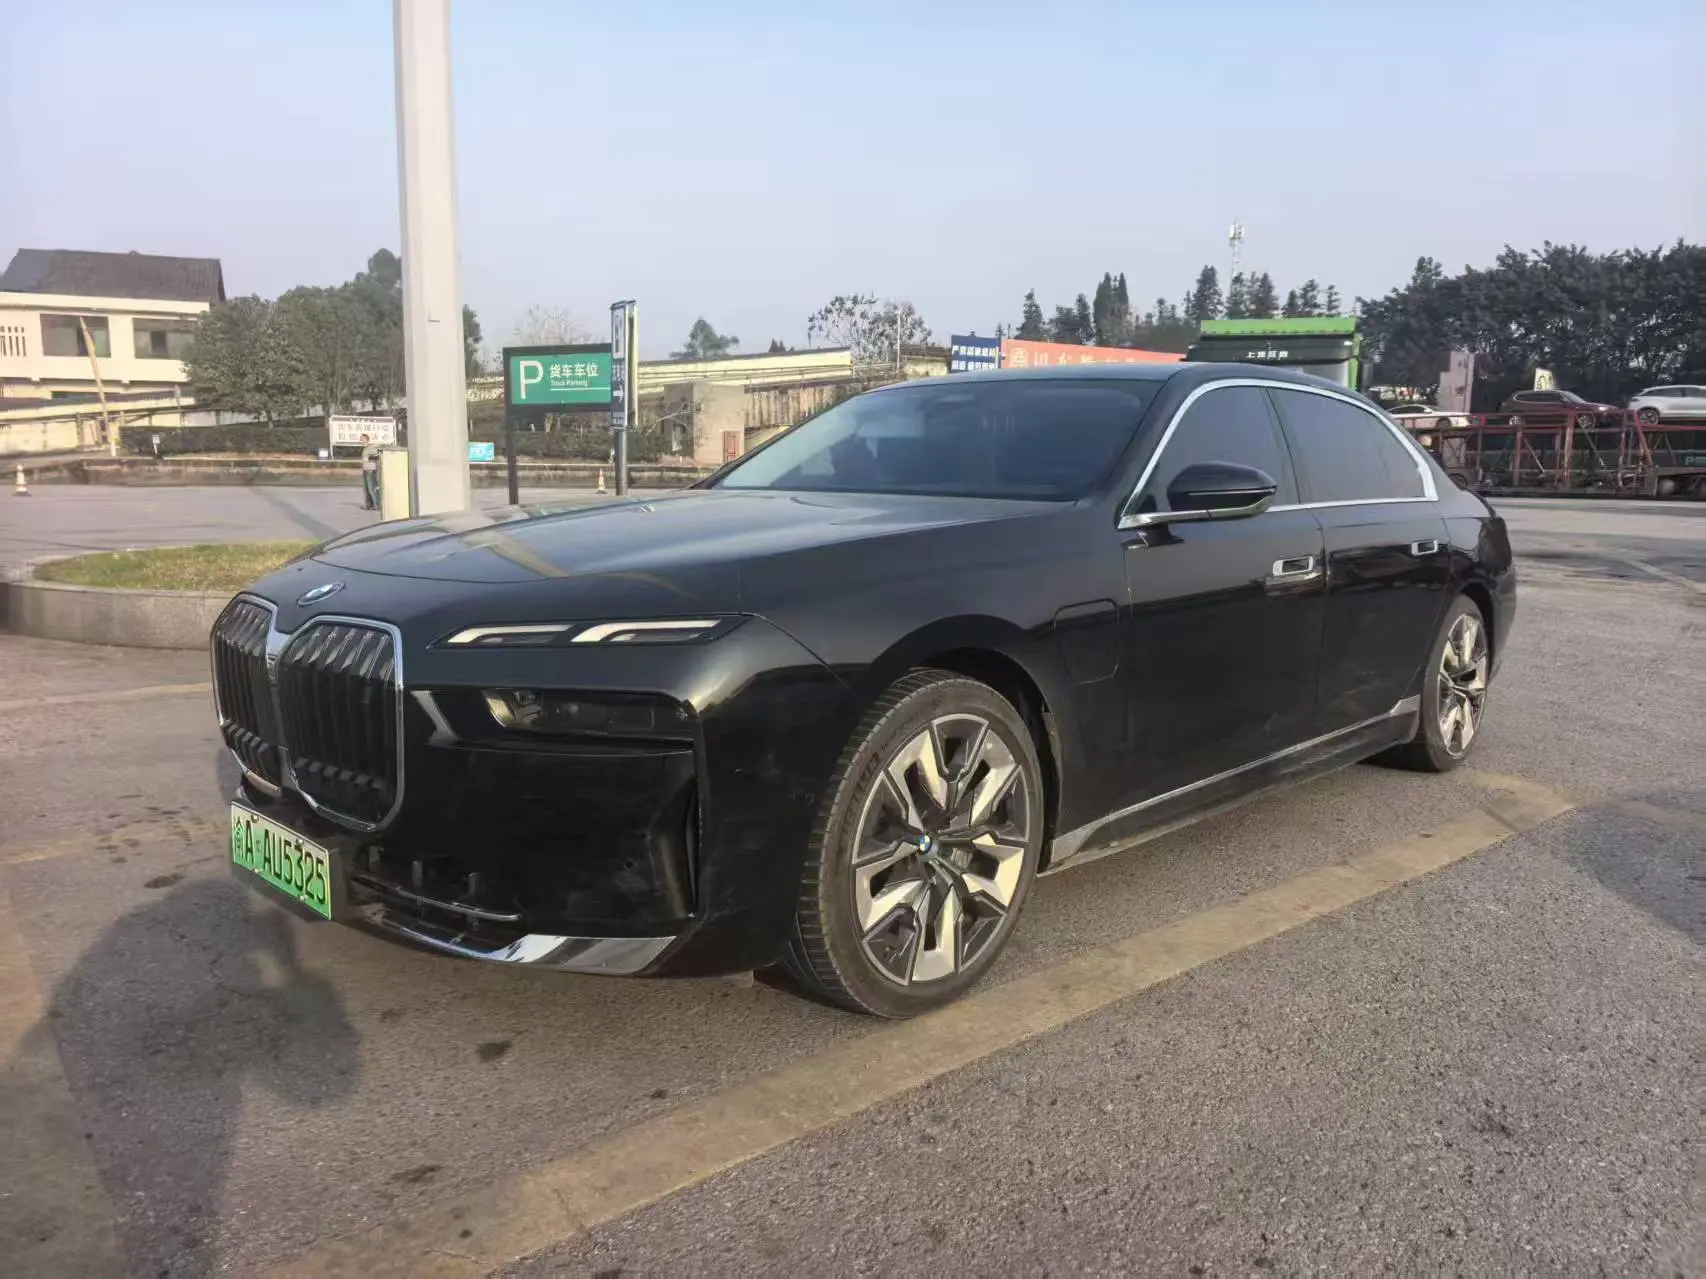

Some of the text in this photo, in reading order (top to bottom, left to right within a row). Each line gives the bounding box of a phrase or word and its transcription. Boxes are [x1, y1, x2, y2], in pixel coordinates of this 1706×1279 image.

[519, 360, 544, 400] P
[549, 362, 599, 378] 货车车位
